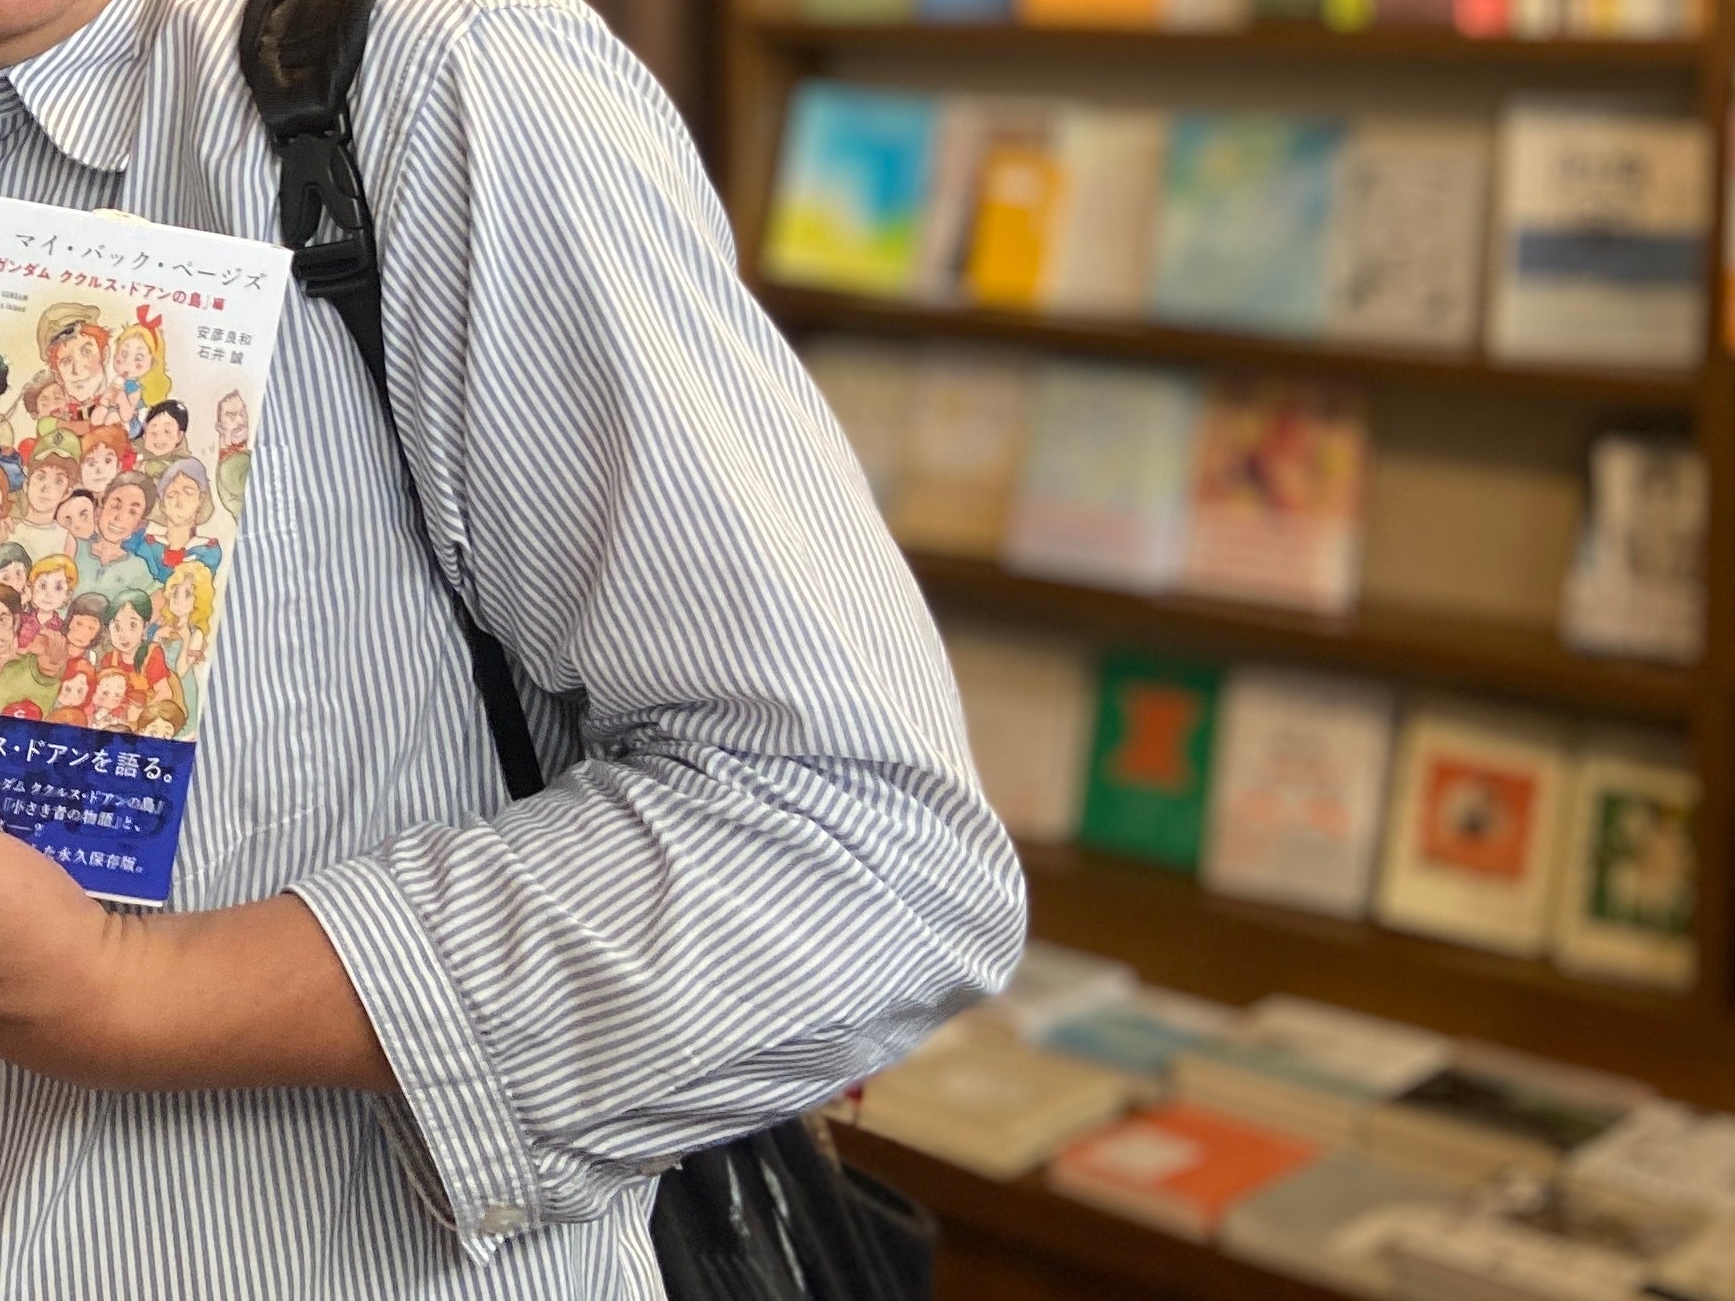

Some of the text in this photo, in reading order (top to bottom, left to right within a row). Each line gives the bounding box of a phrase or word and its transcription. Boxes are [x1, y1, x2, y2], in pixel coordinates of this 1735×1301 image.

[15, 233, 267, 291] マイ・バック・ページズ
[196, 325, 253, 346] 安彦良和
